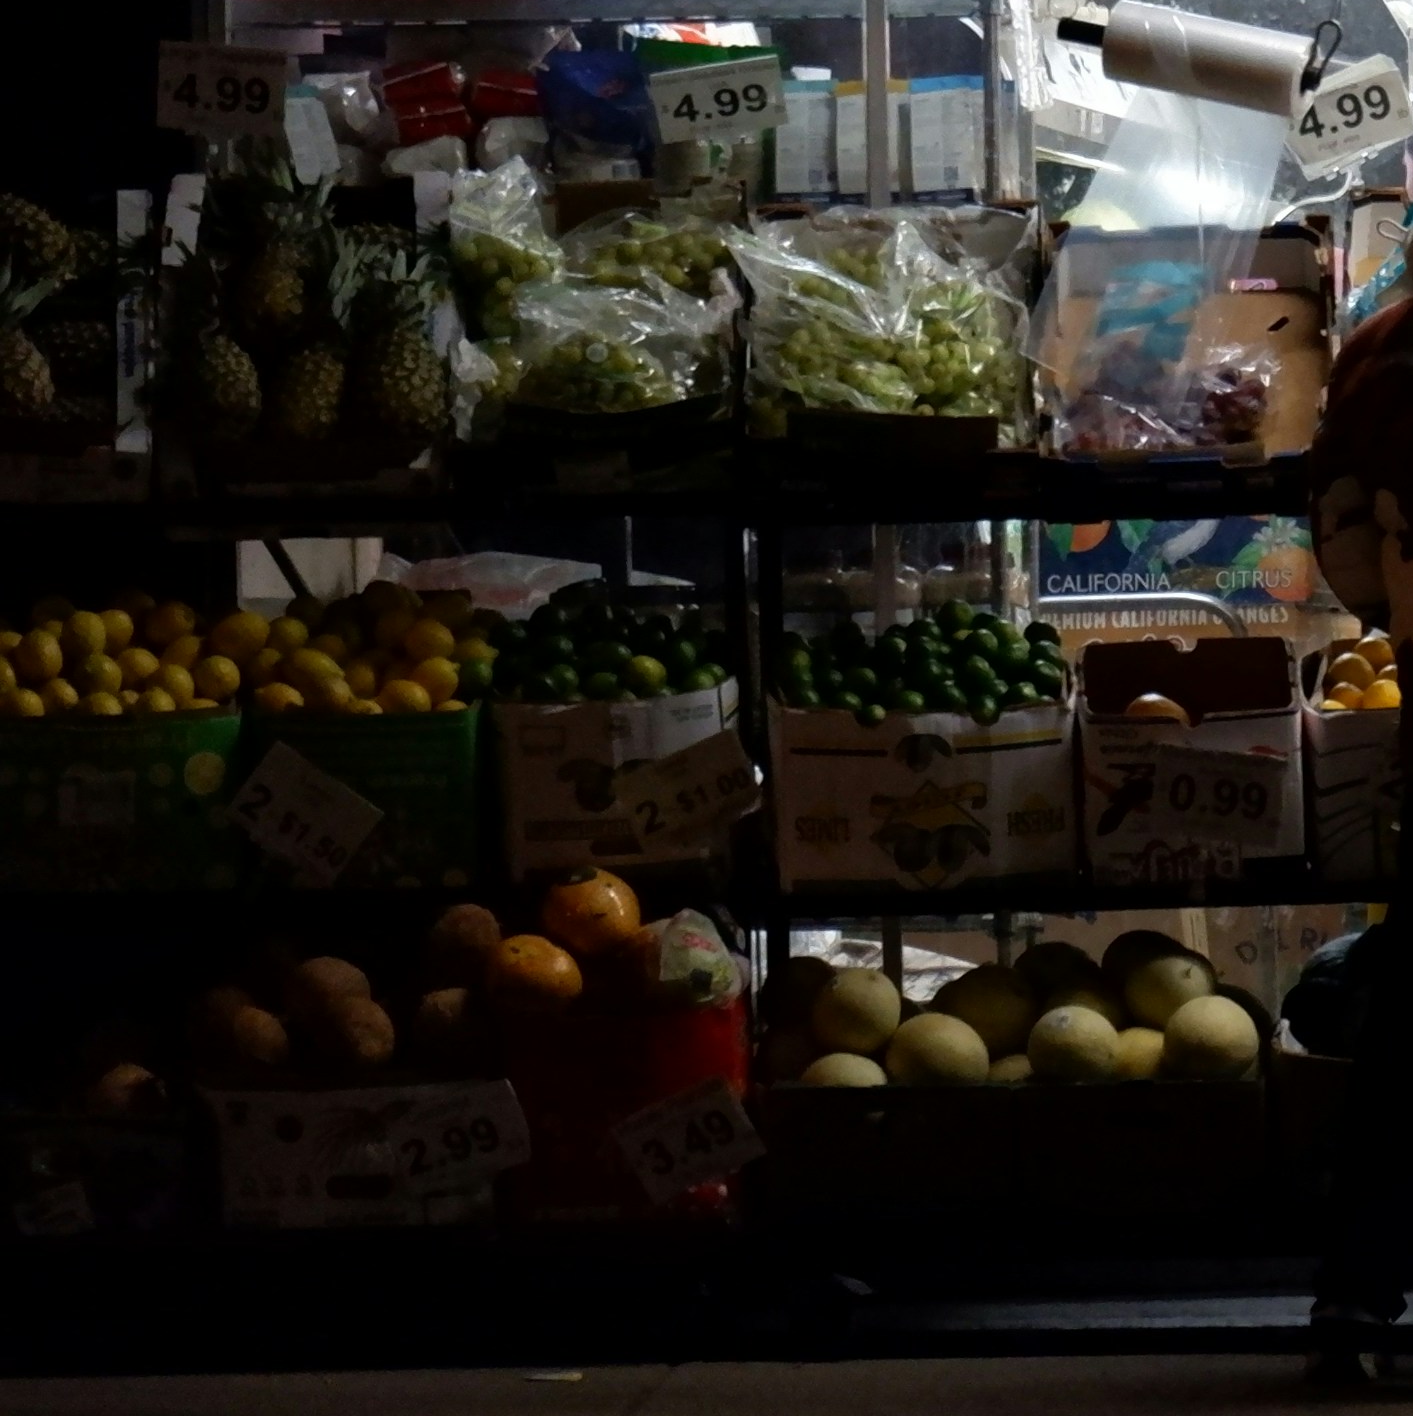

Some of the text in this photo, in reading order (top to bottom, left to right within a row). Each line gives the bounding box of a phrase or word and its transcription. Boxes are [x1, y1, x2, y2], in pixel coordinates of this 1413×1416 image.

[173, 73, 270, 114] 4.99
[673, 84, 768, 122] 4.99
[1299, 85, 1391, 138] 4.99
[1047, 569, 1292, 594] CALIFORNIA CITRUS
[1213, 605, 1289, 627] OANGES
[1169, 773, 1268, 820] 0.99
[795, 816, 850, 842] LIMES
[1008, 808, 1066, 837] FRESH
[401, 1116, 500, 1176] 2.99
[641, 1110, 735, 1175] 3.49
